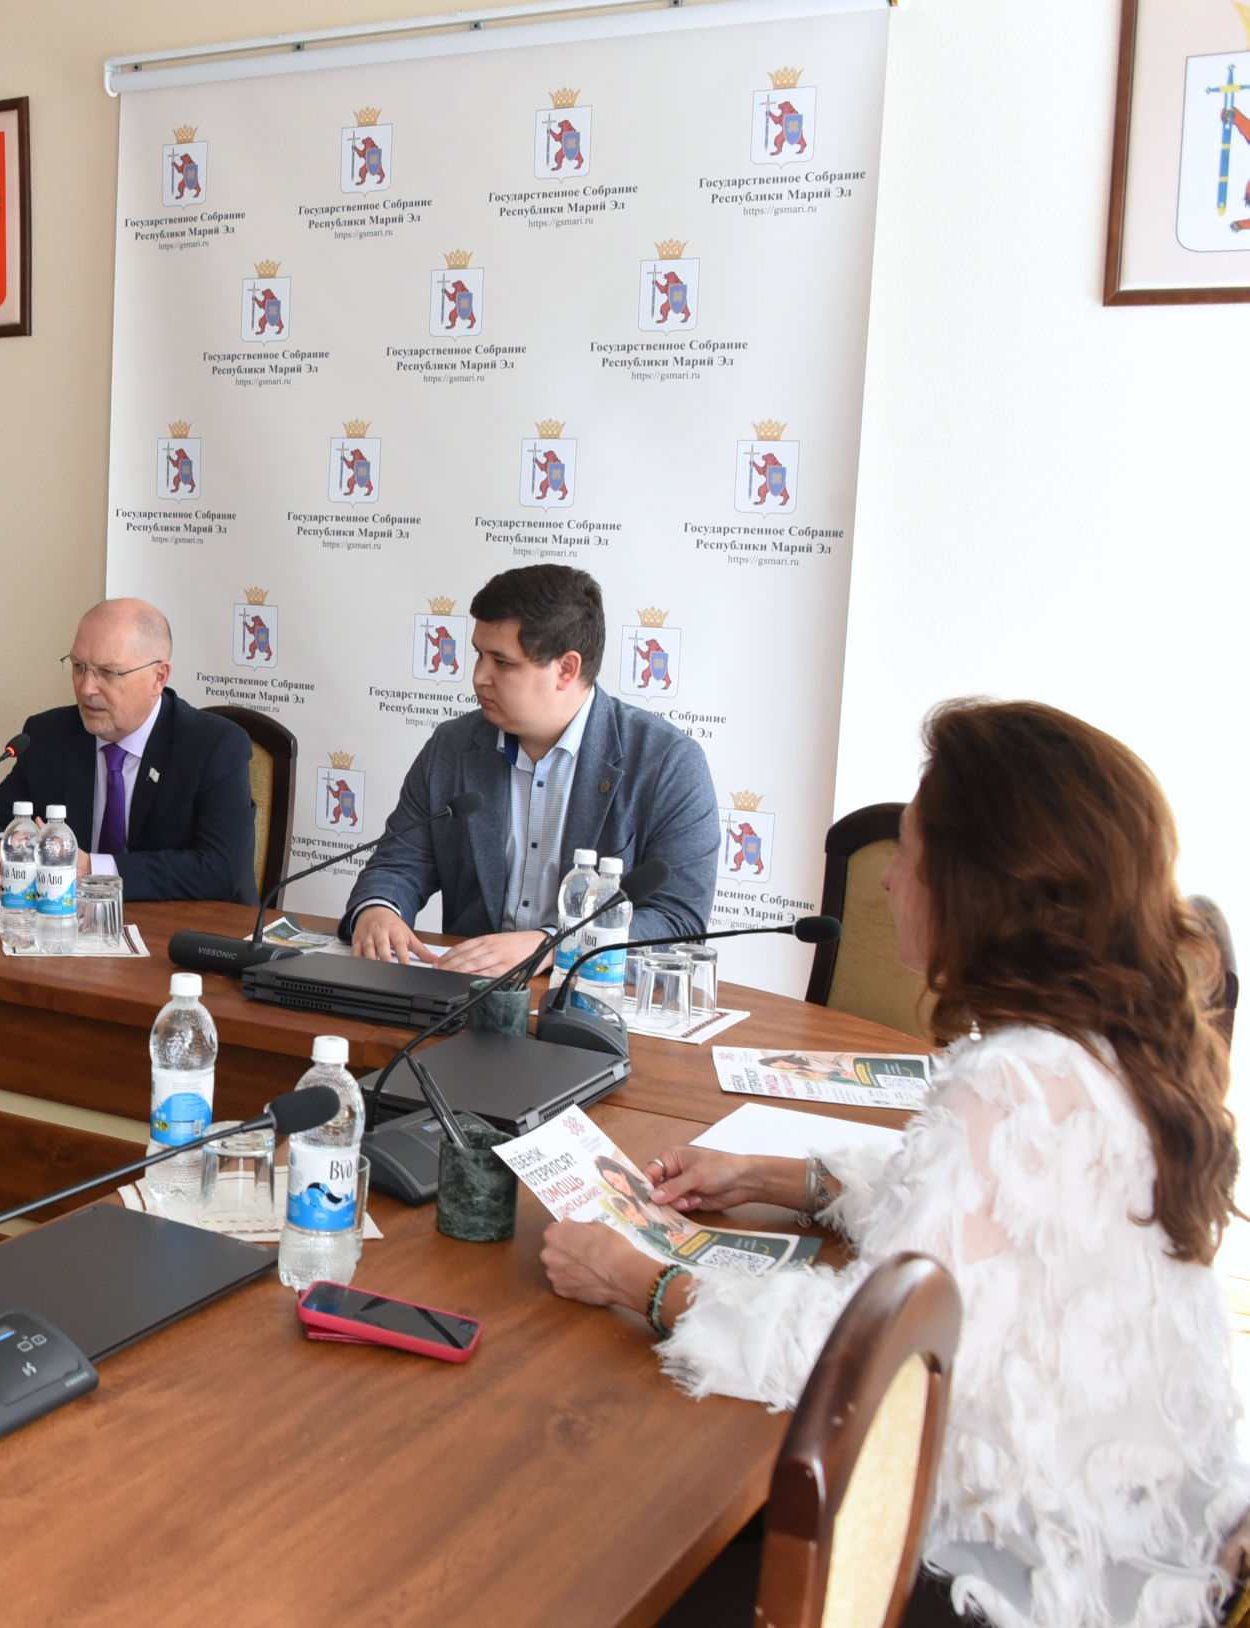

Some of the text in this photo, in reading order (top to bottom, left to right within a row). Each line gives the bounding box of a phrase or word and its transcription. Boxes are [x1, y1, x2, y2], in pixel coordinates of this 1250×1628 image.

[699, 170, 865, 190] Государственное Собрание
[488, 185, 638, 203] Государственное Собрание
[711, 187, 851, 205] Республики Марий Эл
[298, 198, 432, 216] Государственное Собрание
[499, 200, 624, 218] Республики Марий Эл
[743, 206, 816, 217] https://gsmari.ru
[125, 211, 245, 229] Государственное Собрание
[308, 213, 420, 230] Республики Марий Эл
[528, 218, 593, 229] https://gsmari.ru
[135, 225, 234, 241] Республики Марий Эл
[334, 230, 392, 241] https://gsmari.ru
[158, 241, 209, 251] https://gsmari.ru
[386, 344, 526, 358] Государственное Собрание
[590, 339, 748, 354] Государственное Собрание
[203, 349, 329, 363] Государственное Собрание
[602, 356, 733, 369] Республики Марий Эл
[212, 363, 318, 377] Республики Марий Эл
[396, 359, 514, 373] Республики Марий Эл
[235, 378, 291, 387] https://gsmari.ru
[423, 374, 484, 384] https://gsmari.ru
[631, 371, 700, 382] https://gsmari.ru
[115, 508, 237, 521] Государственное Собрание
[287, 511, 421, 526] Государственное Собрание
[126, 522, 226, 535] Республики Марий Эл
[475, 516, 621, 532] Государственное Собрание
[684, 522, 843, 540] Государственное Собрание
[151, 535, 203, 545] https://gsmari.ru
[296, 526, 409, 540] Республики Марий Эл
[485, 532, 608, 547] Республики Марий Эл
[322, 539, 381, 550] https://gsmari.ru
[696, 538, 831, 555] Республики Марий Эл
[513, 546, 577, 558] https://gsmari.ru
[727, 554, 798, 566] https://gsmari.ru
[196, 672, 315, 691] Государственное Собрание
[205, 686, 304, 704] Республики Марий Эл
[369, 686, 454, 702] Государственное
[379, 701, 439, 715] Республики
[669, 709, 727, 724] Собрание
[696, 727, 712, 739] Эл
[760, 893, 815, 911] Собрание
[743, 906, 784, 921] Марий
[198, 946, 238, 961] VISSONIC
